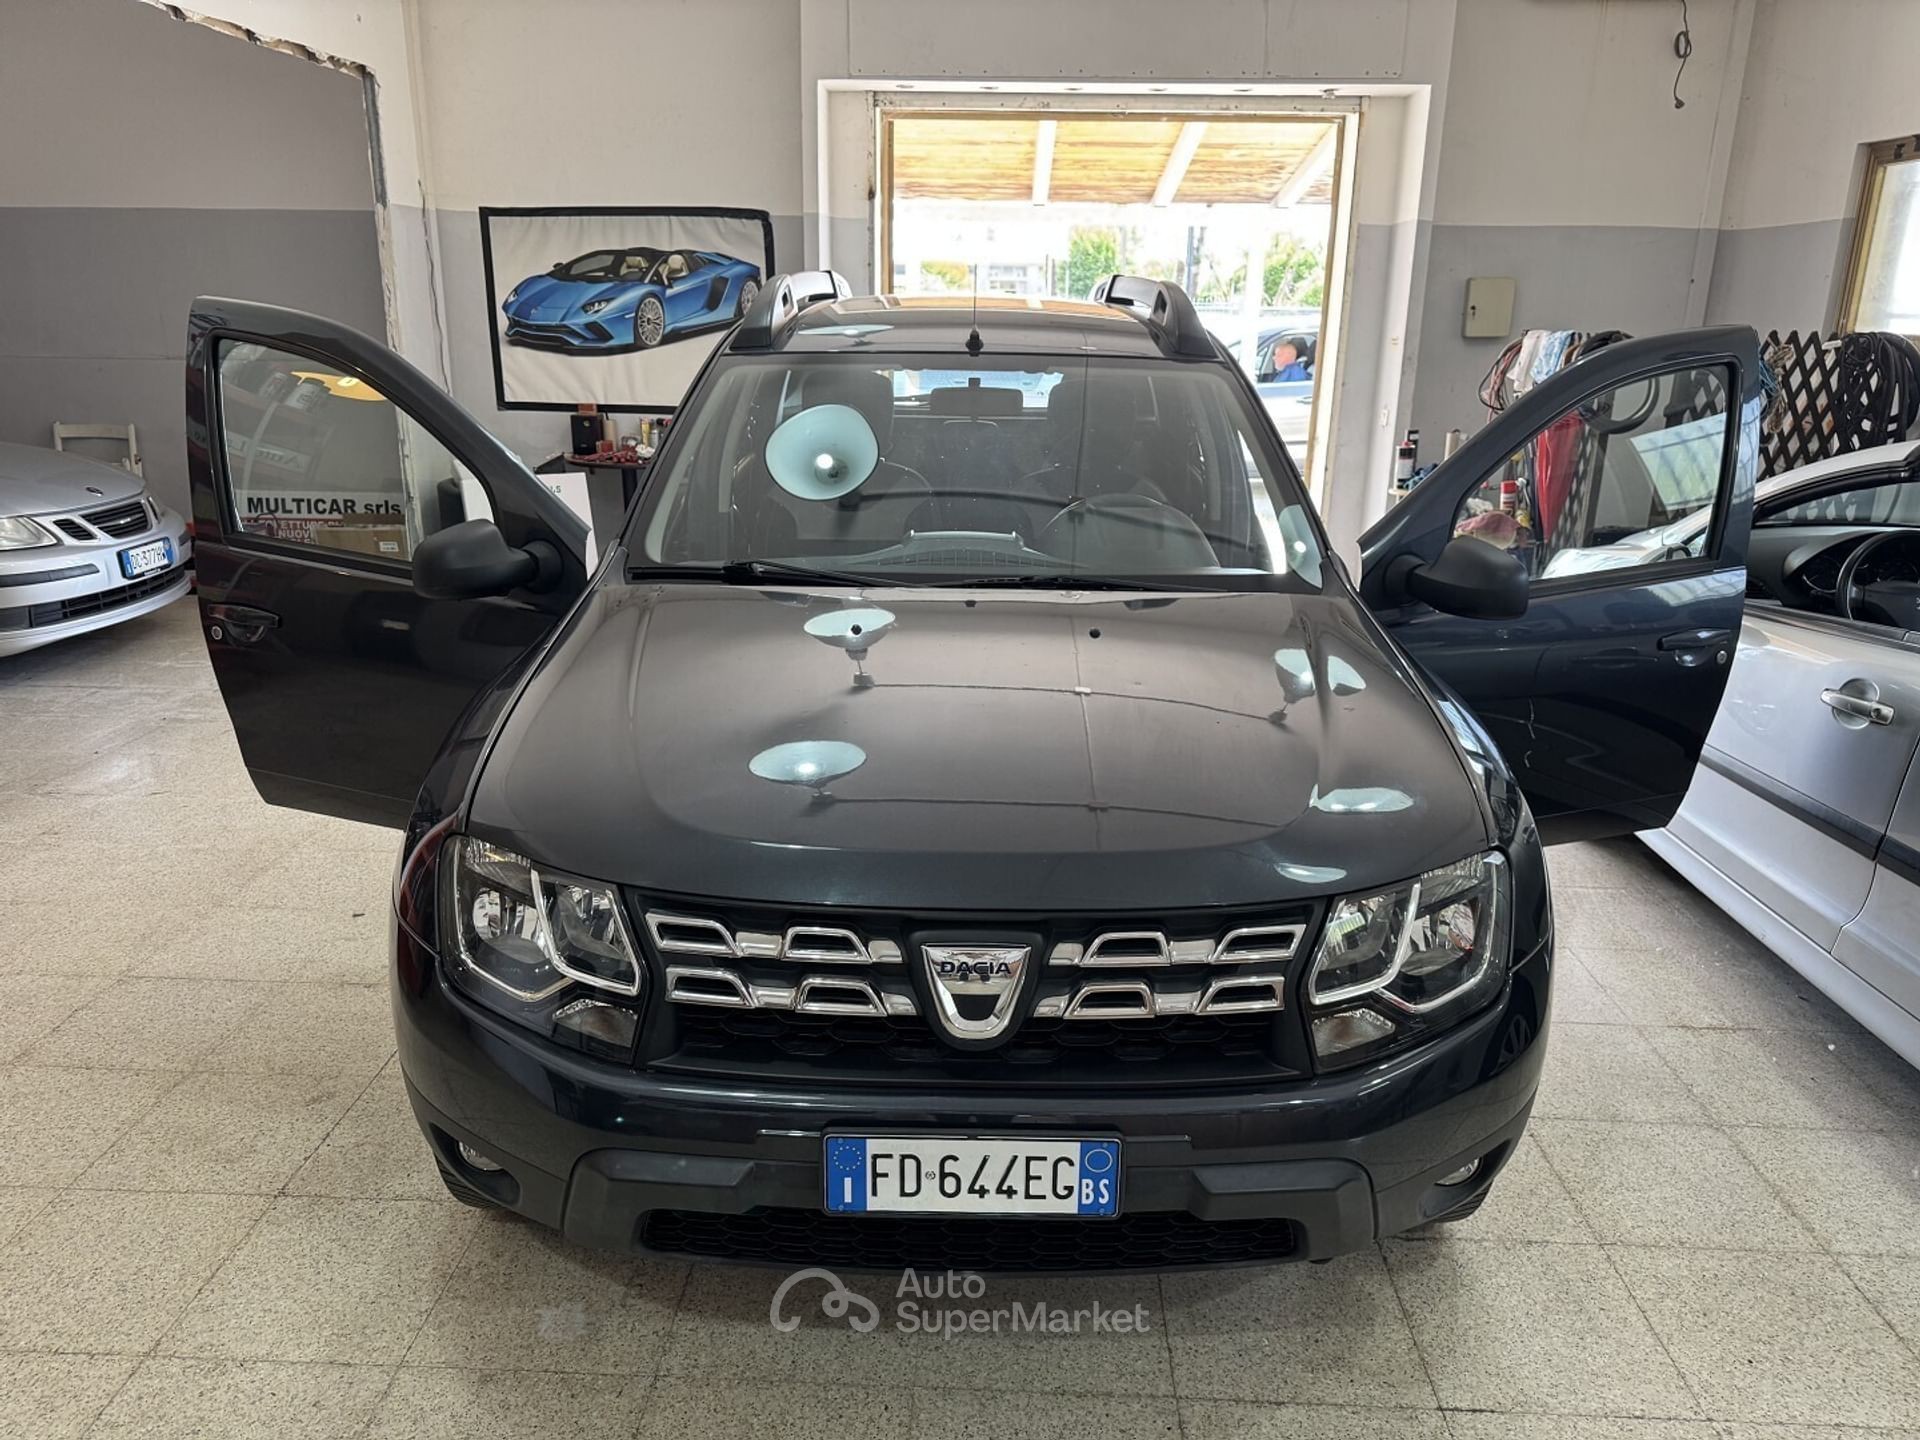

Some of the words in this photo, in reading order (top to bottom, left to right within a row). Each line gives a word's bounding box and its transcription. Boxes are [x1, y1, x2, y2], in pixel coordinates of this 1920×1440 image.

[247, 497, 356, 514] MULTICAR
[364, 500, 401, 515] srls
[941, 961, 1011, 975] DACIA
[1081, 1178, 1110, 1205] BS
